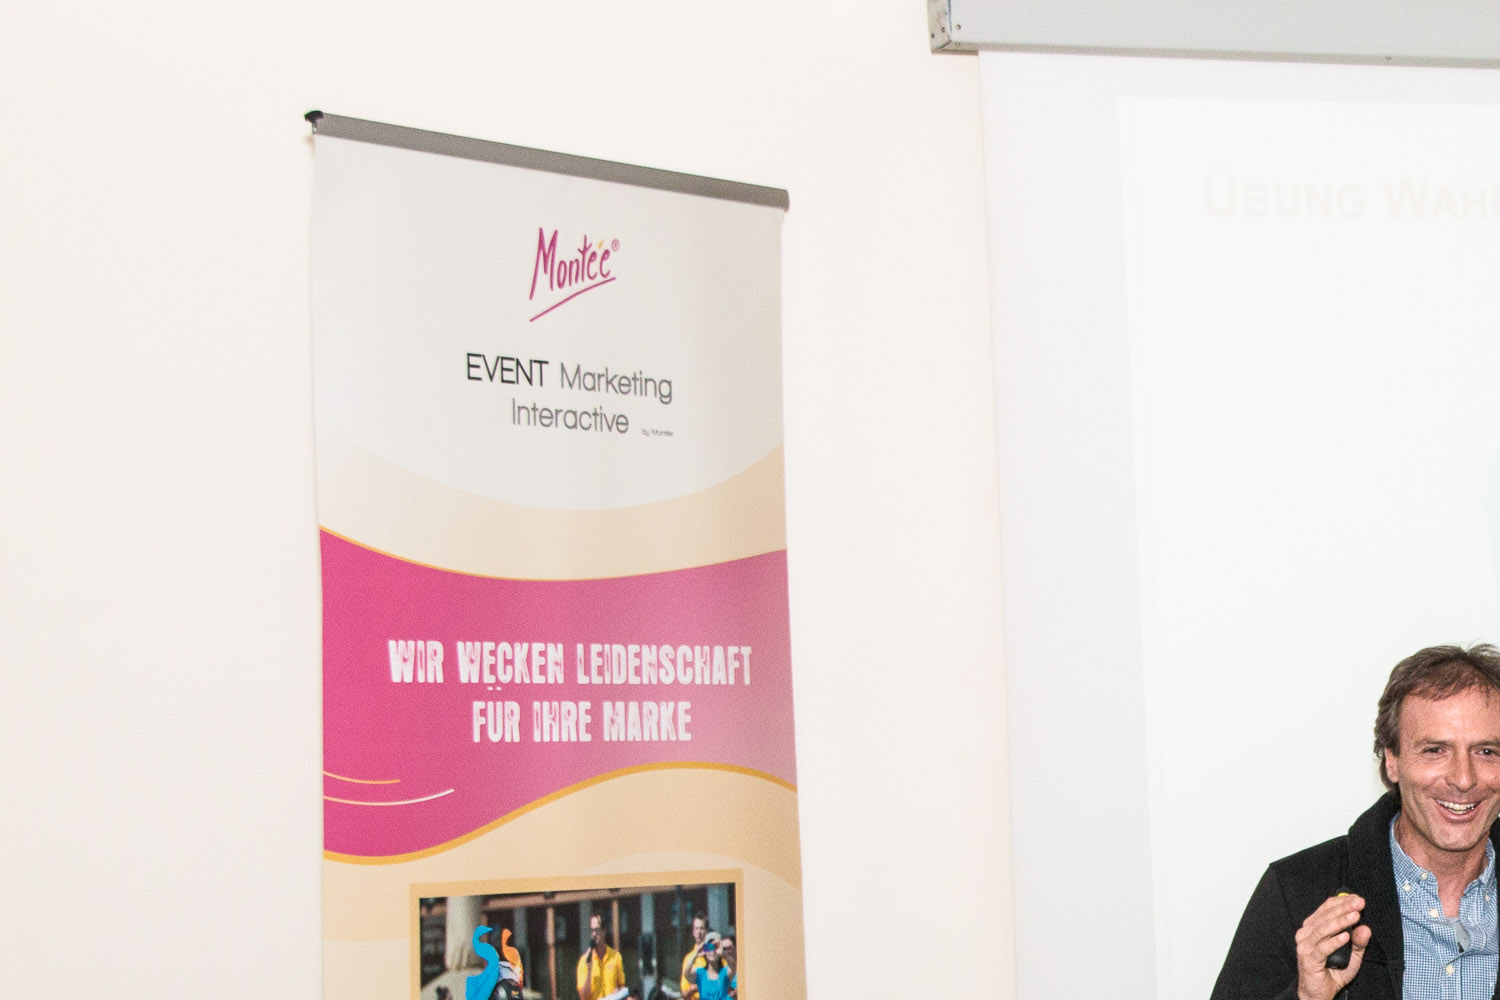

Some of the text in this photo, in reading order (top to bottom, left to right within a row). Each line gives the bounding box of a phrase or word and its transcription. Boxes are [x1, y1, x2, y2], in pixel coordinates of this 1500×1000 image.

[1203, 165, 1367, 219] ÜBUNG
[466, 352, 673, 404] EVENT Marketing
[512, 397, 629, 433] Interactive
[388, 639, 753, 686] WIR WECKEN LEIDENSCHAFT
[472, 686, 692, 743] FÜR IHRE MARKE
